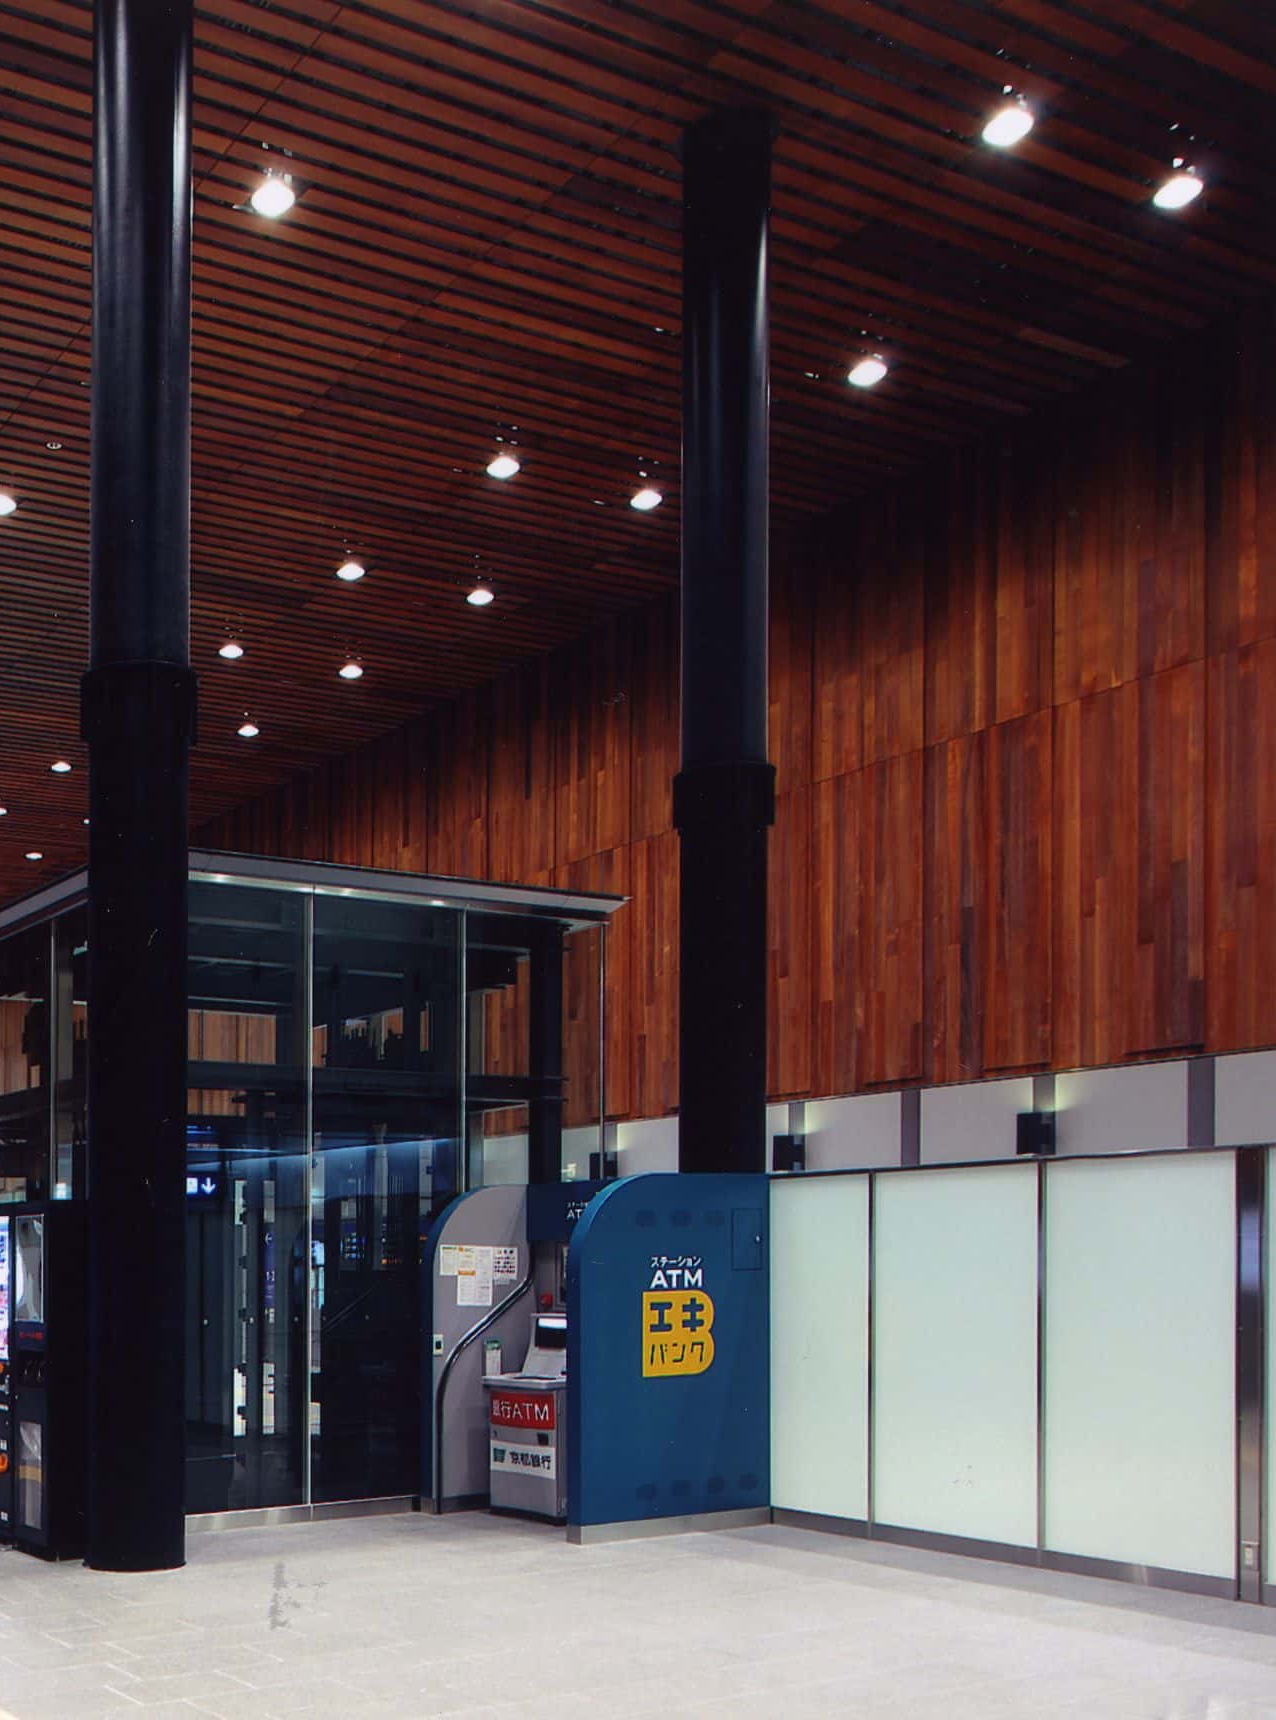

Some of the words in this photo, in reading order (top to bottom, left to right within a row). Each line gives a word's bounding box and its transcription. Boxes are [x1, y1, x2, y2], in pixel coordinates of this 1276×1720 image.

[566, 1208, 583, 1220] AT
[650, 1256, 702, 1268] ステーション
[650, 1269, 703, 1289] ATM
[649, 1297, 705, 1333] エキ
[650, 1341, 705, 1366] バンク
